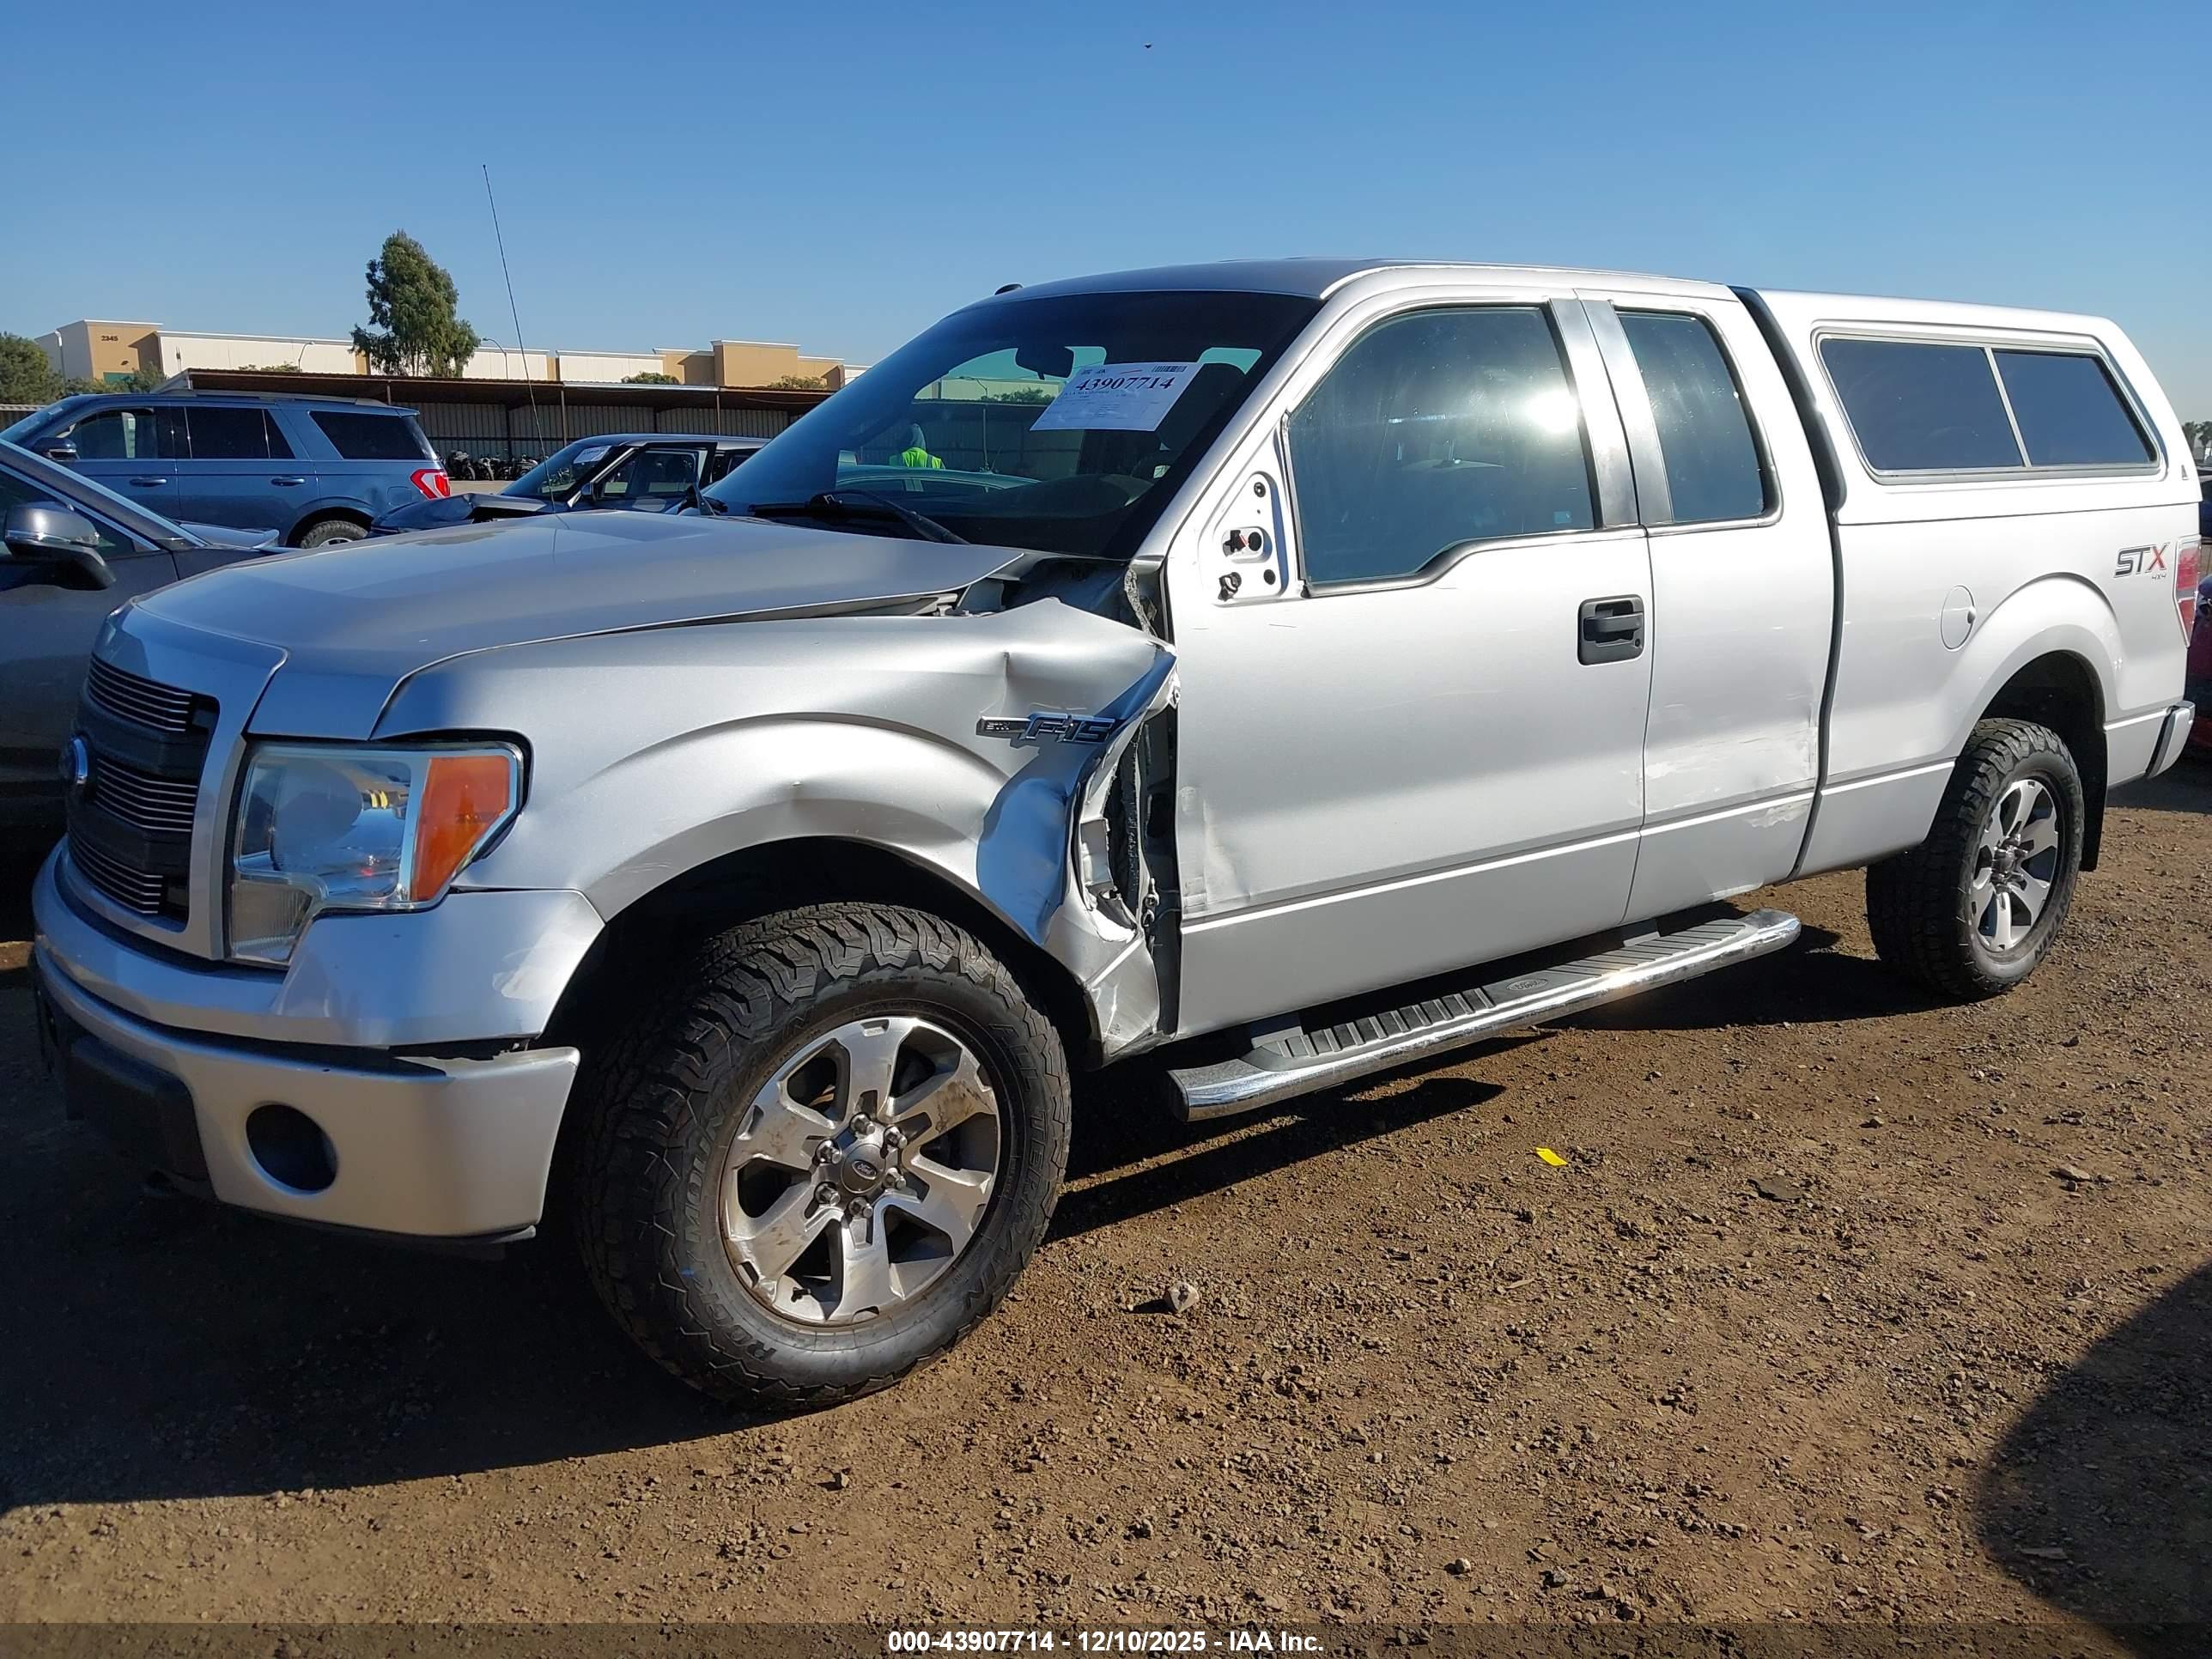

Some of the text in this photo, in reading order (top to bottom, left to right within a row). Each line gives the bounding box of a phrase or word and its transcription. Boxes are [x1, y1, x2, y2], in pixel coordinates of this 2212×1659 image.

[1075, 376, 1176, 392] 43907714
[2113, 542, 2171, 578] STX
[1024, 711, 1116, 744] F-15
[988, 1023, 1040, 1092] ALL
